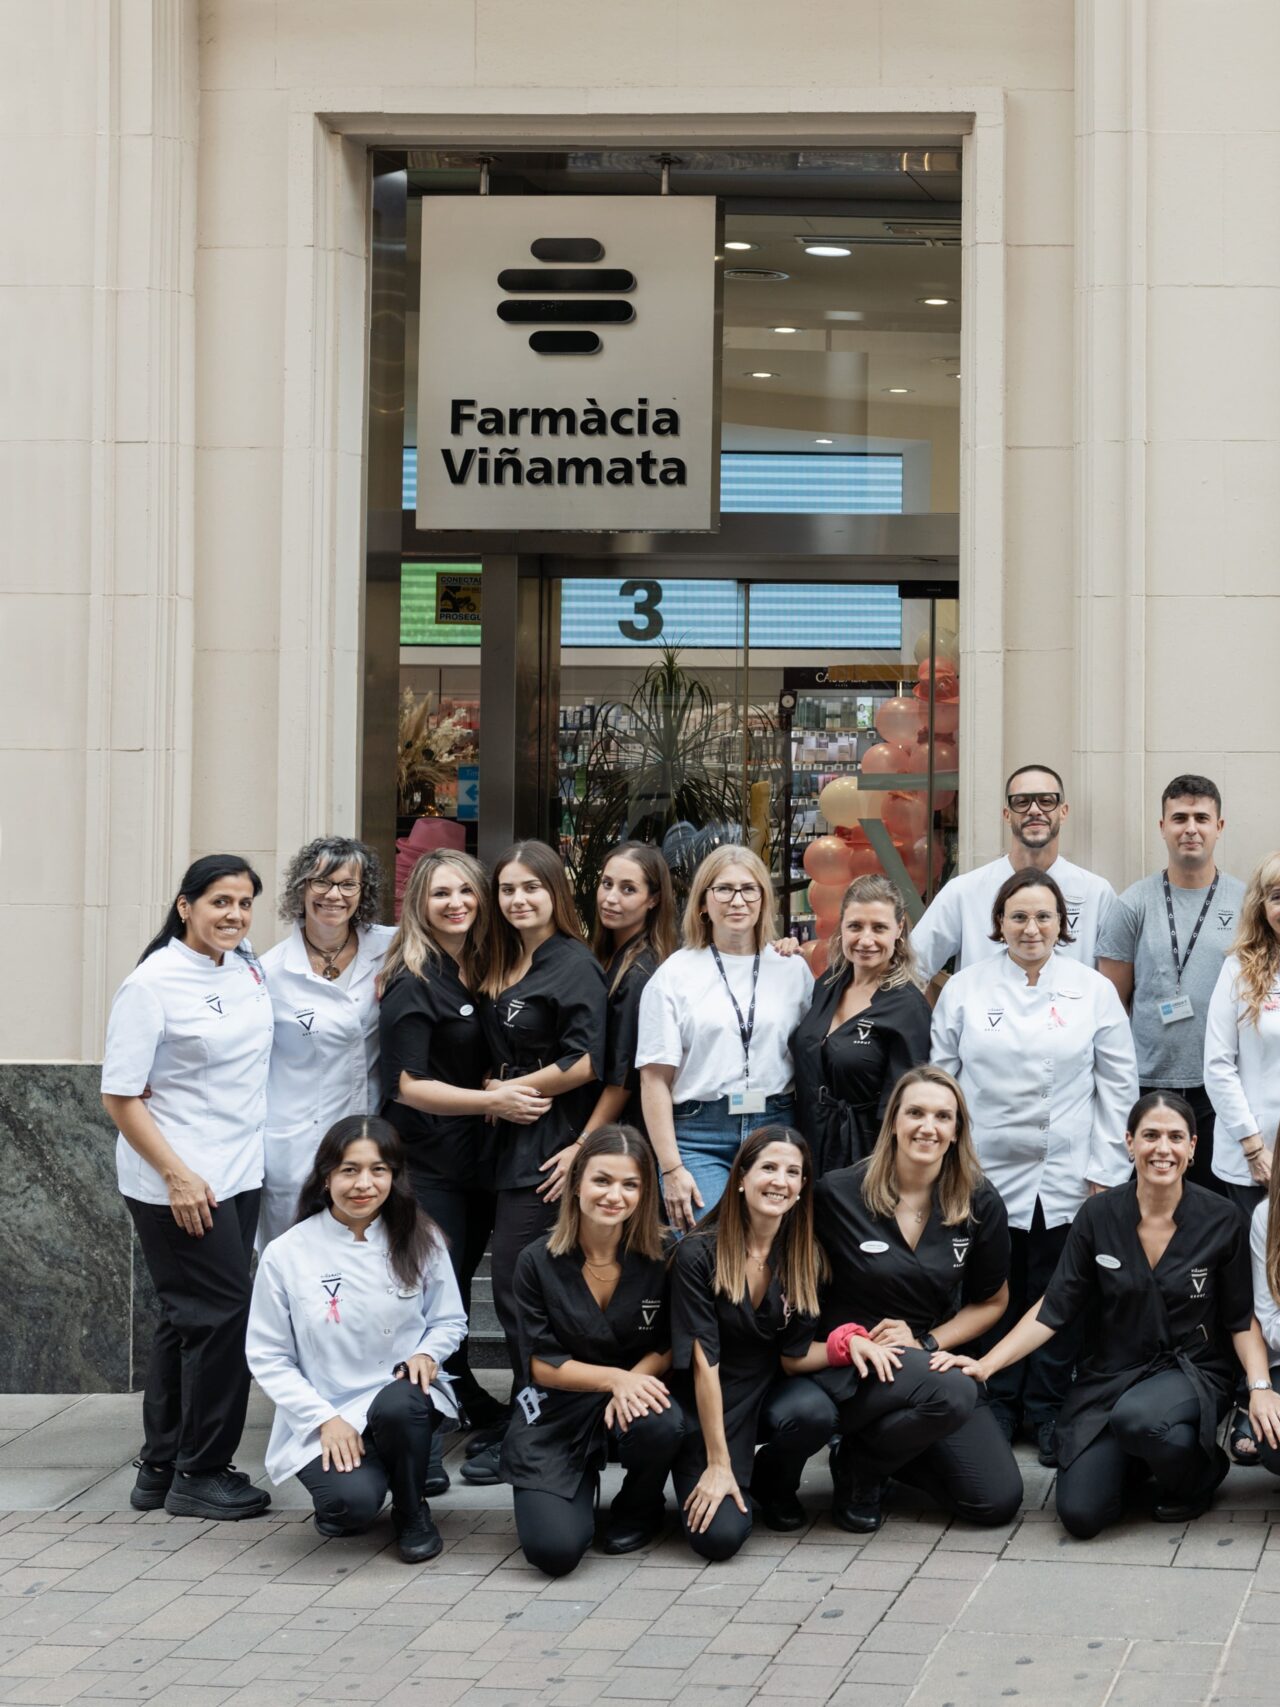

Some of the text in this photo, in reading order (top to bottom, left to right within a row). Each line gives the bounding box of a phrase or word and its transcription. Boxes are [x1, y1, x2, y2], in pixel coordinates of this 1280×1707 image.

[450, 397, 680, 437] Farmàcia
[441, 446, 687, 487] Viñamata
[440, 575, 482, 584] CONECTA
[618, 579, 664, 642] 3
